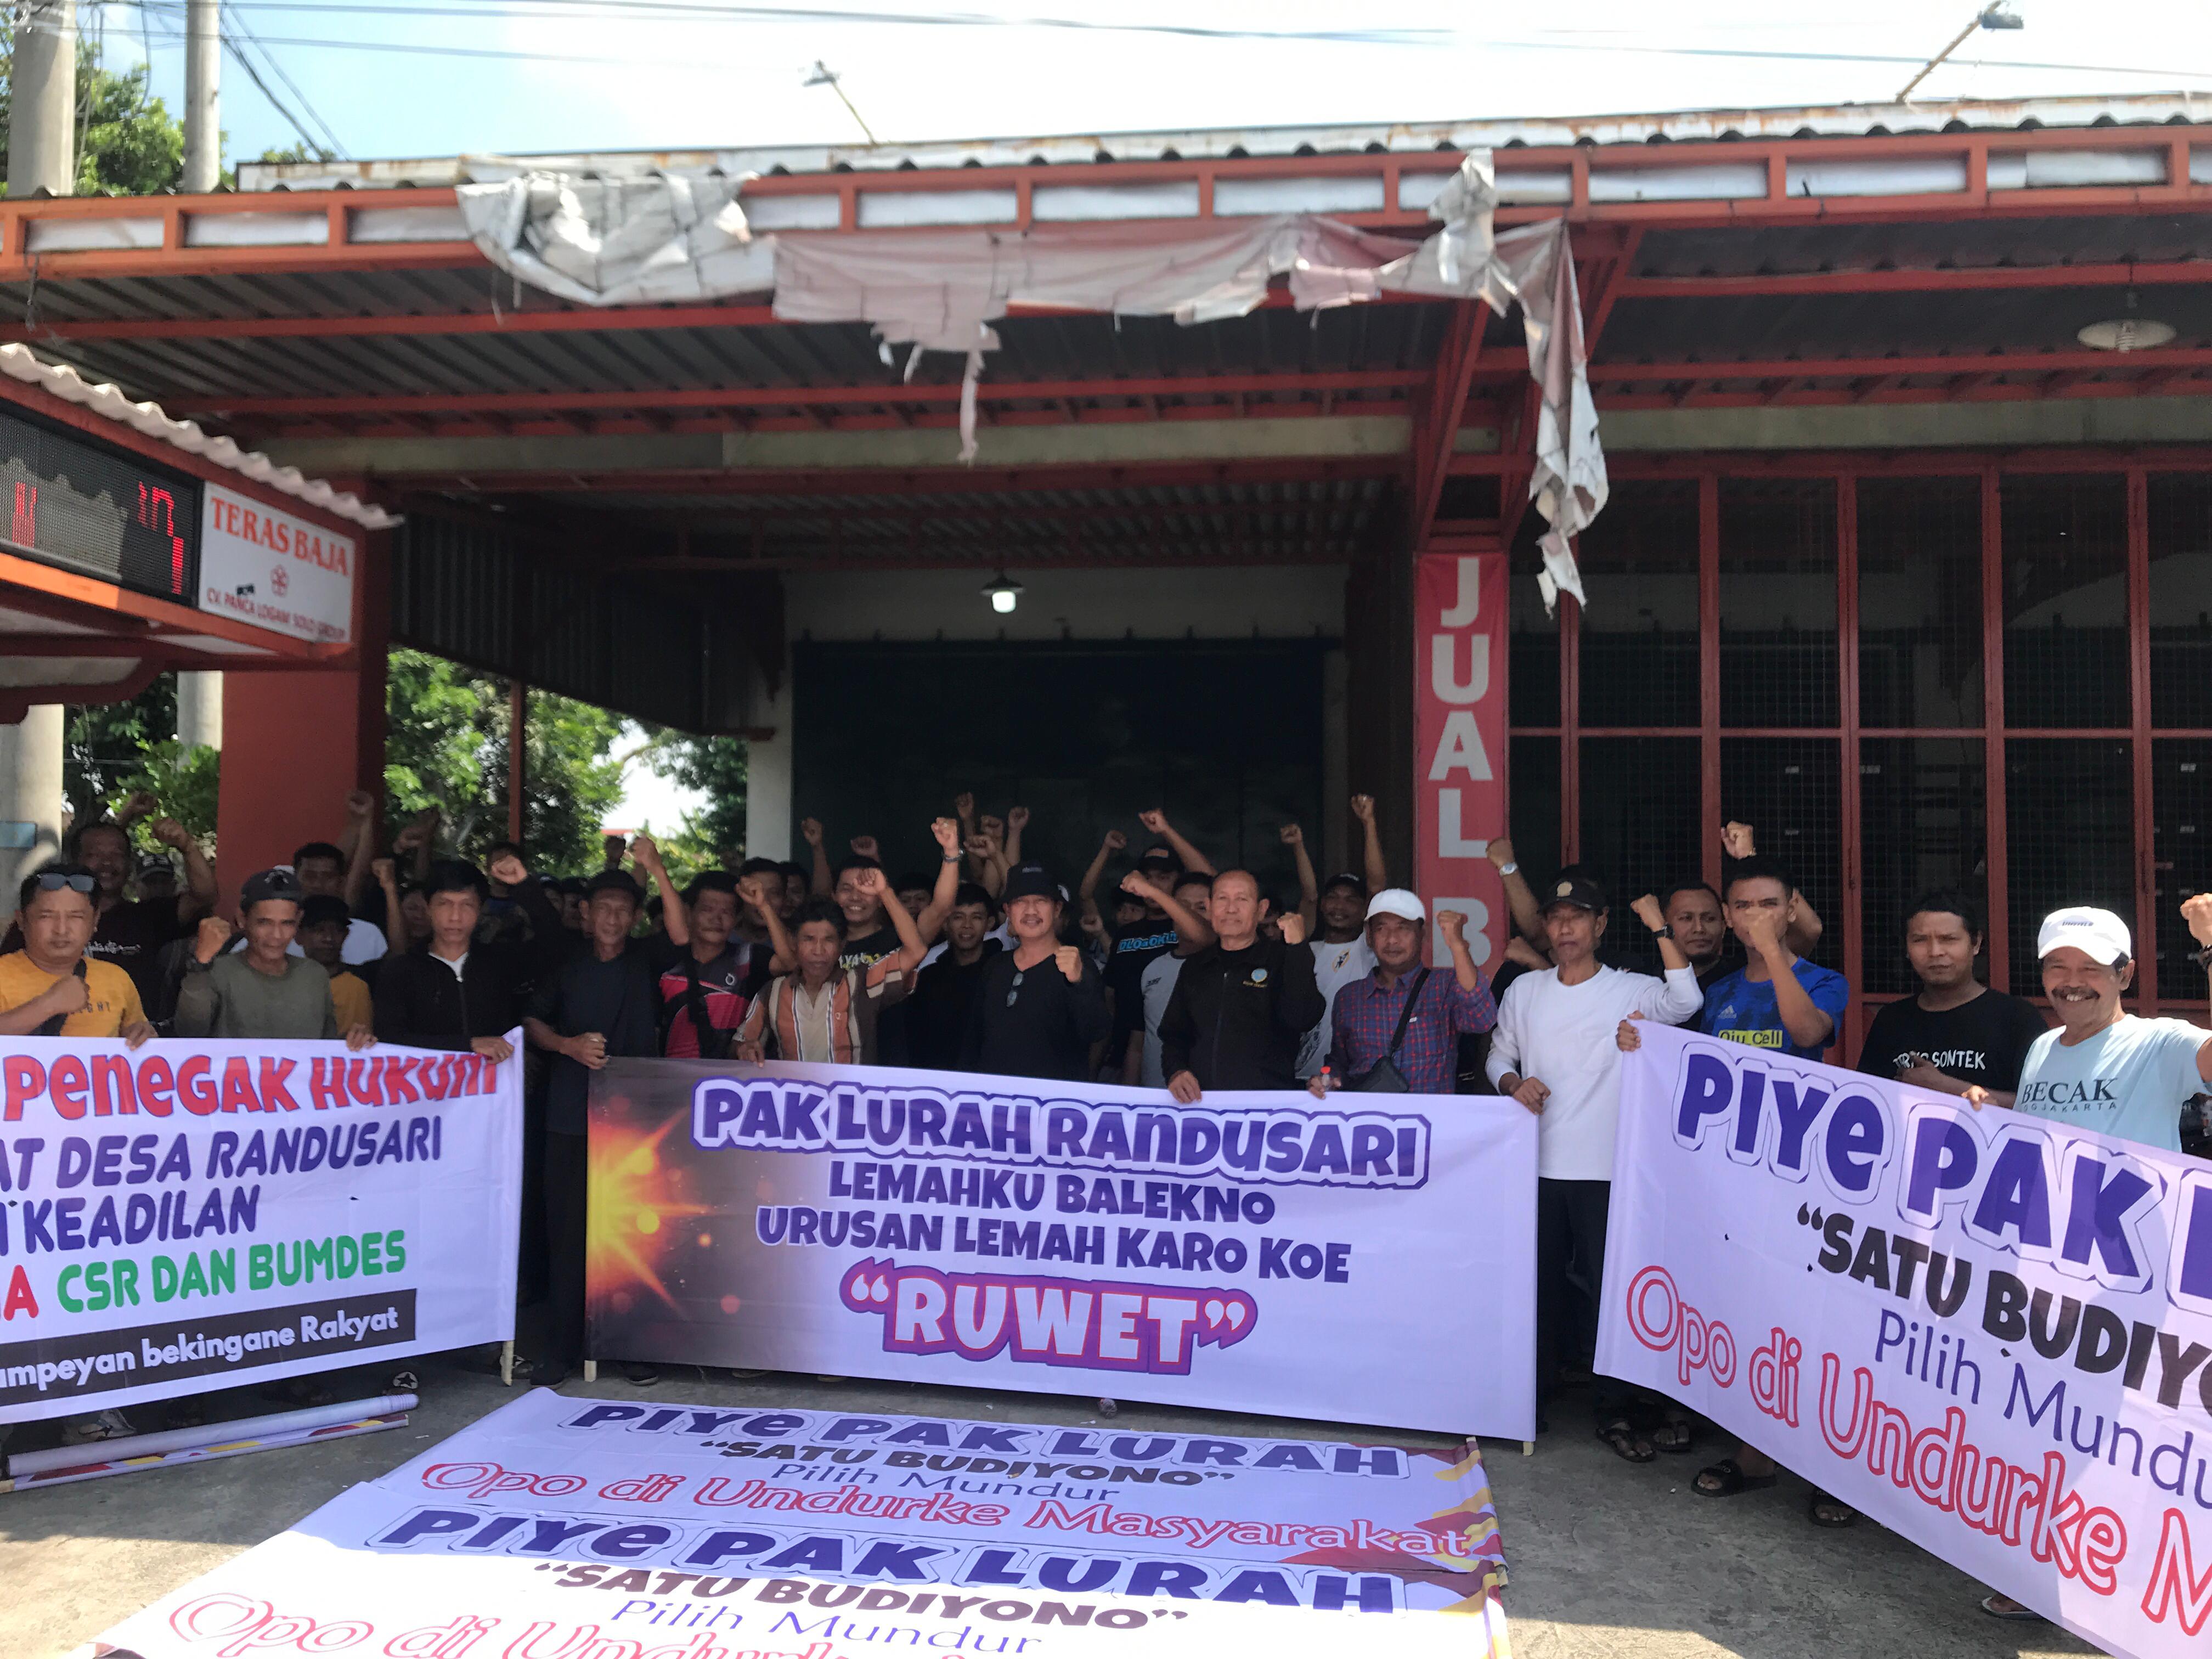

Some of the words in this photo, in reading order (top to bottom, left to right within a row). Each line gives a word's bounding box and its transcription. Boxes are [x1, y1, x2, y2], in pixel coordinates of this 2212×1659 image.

[211, 495, 290, 554] TERAS
[294, 529, 349, 577] BAJA
[1427, 557, 1493, 858] JUAL
[1932, 1049, 1985, 1070] SONTEK
[2022, 1077, 2118, 1104] BECAK
[57, 1132, 191, 1189] DESA
[206, 1115, 442, 1180] RANDUSARI
[702, 1088, 823, 1141] PAK
[835, 1094, 1032, 1155] LURAH
[22, 1184, 261, 1254] KEADILAN
[829, 1160, 1045, 1212] LEMAHKU
[1056, 1174, 1276, 1225] BALEKNO
[1906, 1117, 2154, 1278] PAK
[57, 1259, 140, 1313] CSR
[151, 1247, 236, 1303] DAN
[249, 1229, 407, 1291] BUMDES
[757, 1206, 944, 1252] URUSAN
[954, 1216, 1105, 1265] LEMAH
[1116, 1226, 1248, 1274] KARO
[1258, 1237, 1352, 1284] KOE
[141, 1327, 296, 1368] bekingane
[300, 1307, 399, 1342] Rakyat
[1875, 1308, 1982, 1404] Pilih
[1982, 1270, 2212, 1419] BUDIY
[822, 1418, 1032, 1453] PAK
[1049, 1431, 1398, 1476] LURAH
[1626, 1265, 1737, 1389] Opo
[1749, 1327, 1802, 1428] di
[1819, 1352, 2128, 1596] Undurke
[421, 1462, 588, 1499] Opo
[598, 1474, 687, 1502] di
[693, 1477, 1011, 1526] Undurke
[1023, 1499, 1472, 1558] Masyarakat
[770, 1463, 878, 1483] Pilih
[898, 1472, 1120, 1501] Mundur
[684, 1531, 948, 1580] PAK
[964, 1549, 1393, 1614] LURAH
[168, 1592, 375, 1658] Opo
[610, 1600, 744, 1630] Pilih
[768, 1611, 1042, 1653] Mundur
